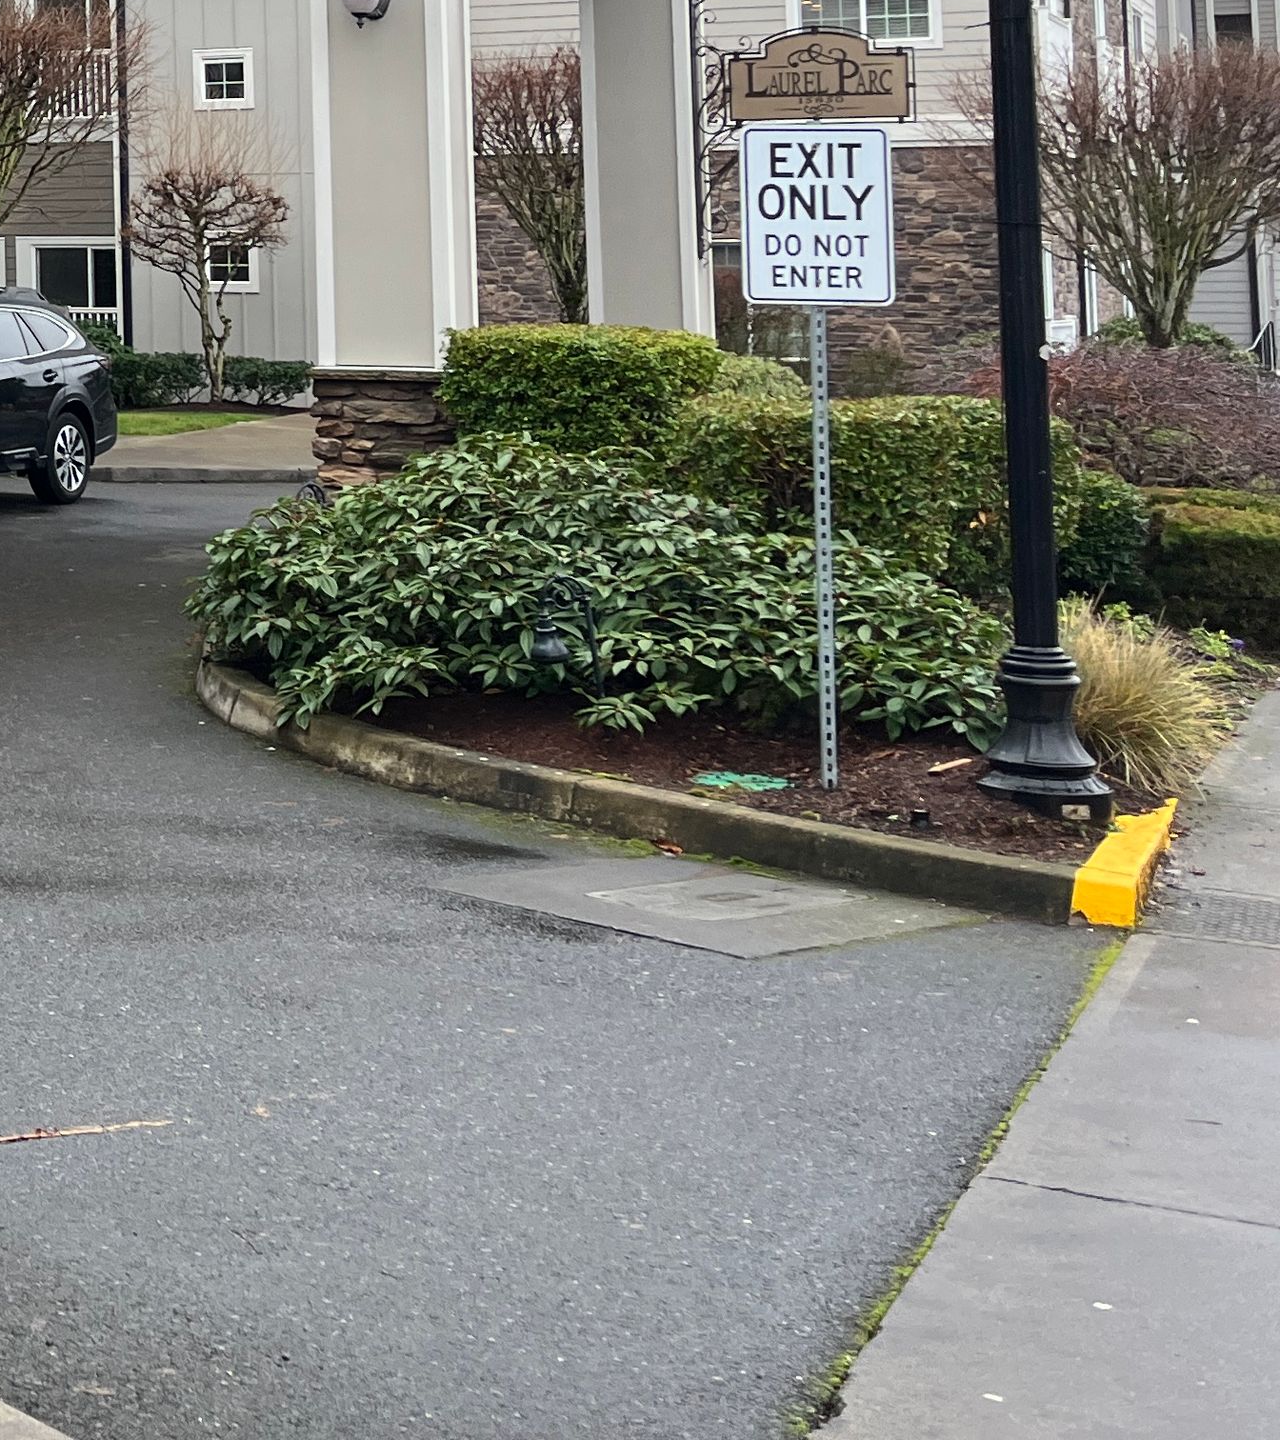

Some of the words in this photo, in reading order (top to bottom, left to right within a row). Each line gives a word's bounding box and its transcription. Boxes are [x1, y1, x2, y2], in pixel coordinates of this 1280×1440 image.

[744, 62, 829, 98] LAUREL
[836, 60, 893, 96] PARC
[770, 142, 862, 179] EXIT
[757, 184, 874, 221] ONLY
[765, 234, 802, 257] DO
[814, 234, 870, 257] NOT
[772, 266, 863, 289] ENTER
